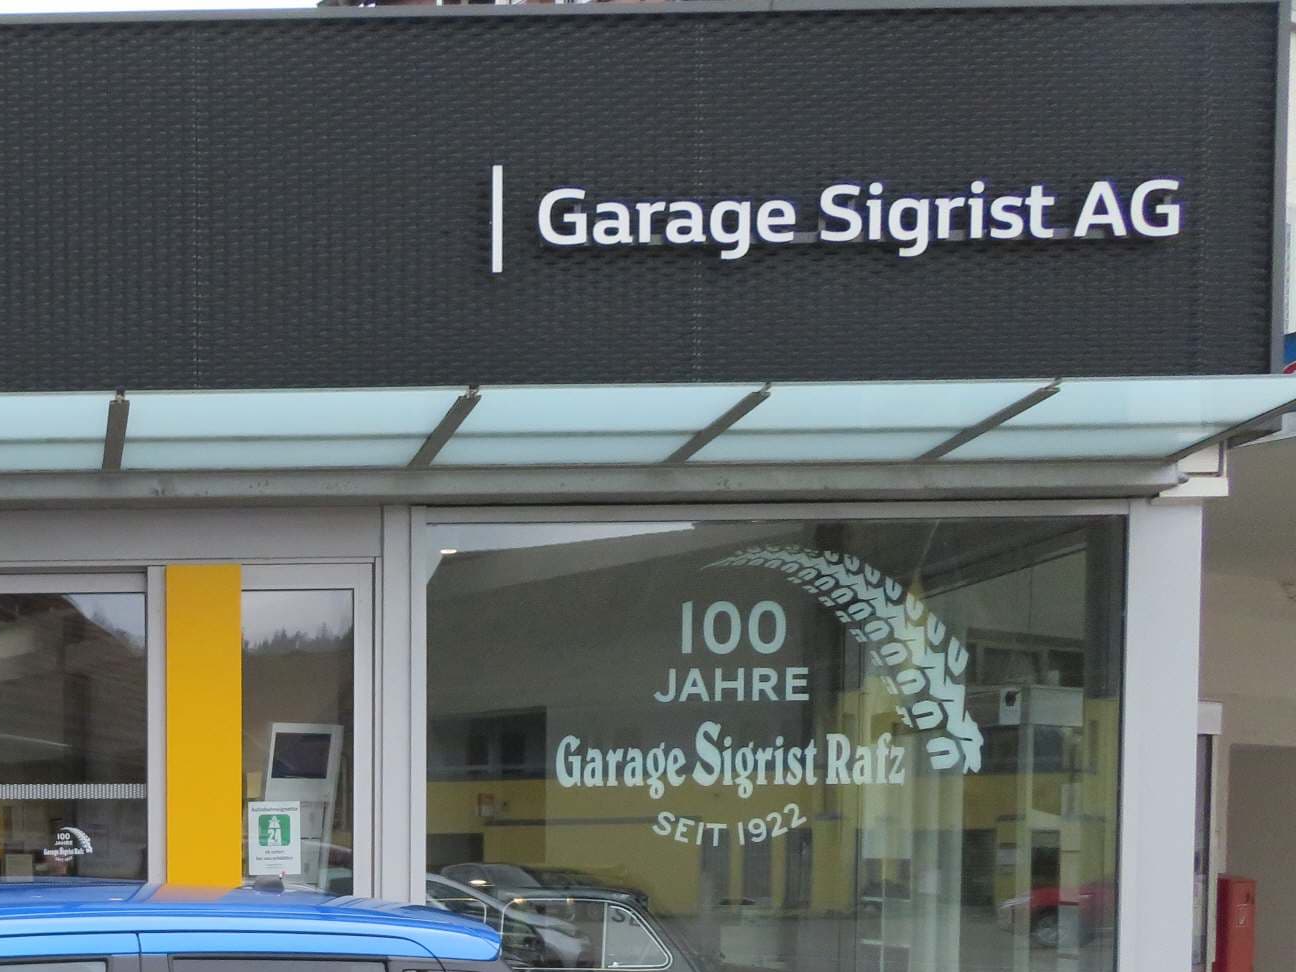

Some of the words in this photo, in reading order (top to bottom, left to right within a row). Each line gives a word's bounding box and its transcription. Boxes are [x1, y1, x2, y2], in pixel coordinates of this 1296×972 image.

[538, 188, 796, 260] Garage
[820, 181, 1055, 257] Sigrist
[1073, 179, 1180, 237] AG
[681, 600, 787, 655] 100
[654, 667, 809, 702] JAHRE
[555, 735, 686, 800] Garage
[692, 721, 818, 799] Sigrist
[826, 732, 906, 787] Rafz
[652, 811, 727, 847] SEIT
[738, 803, 807, 846] 1922
